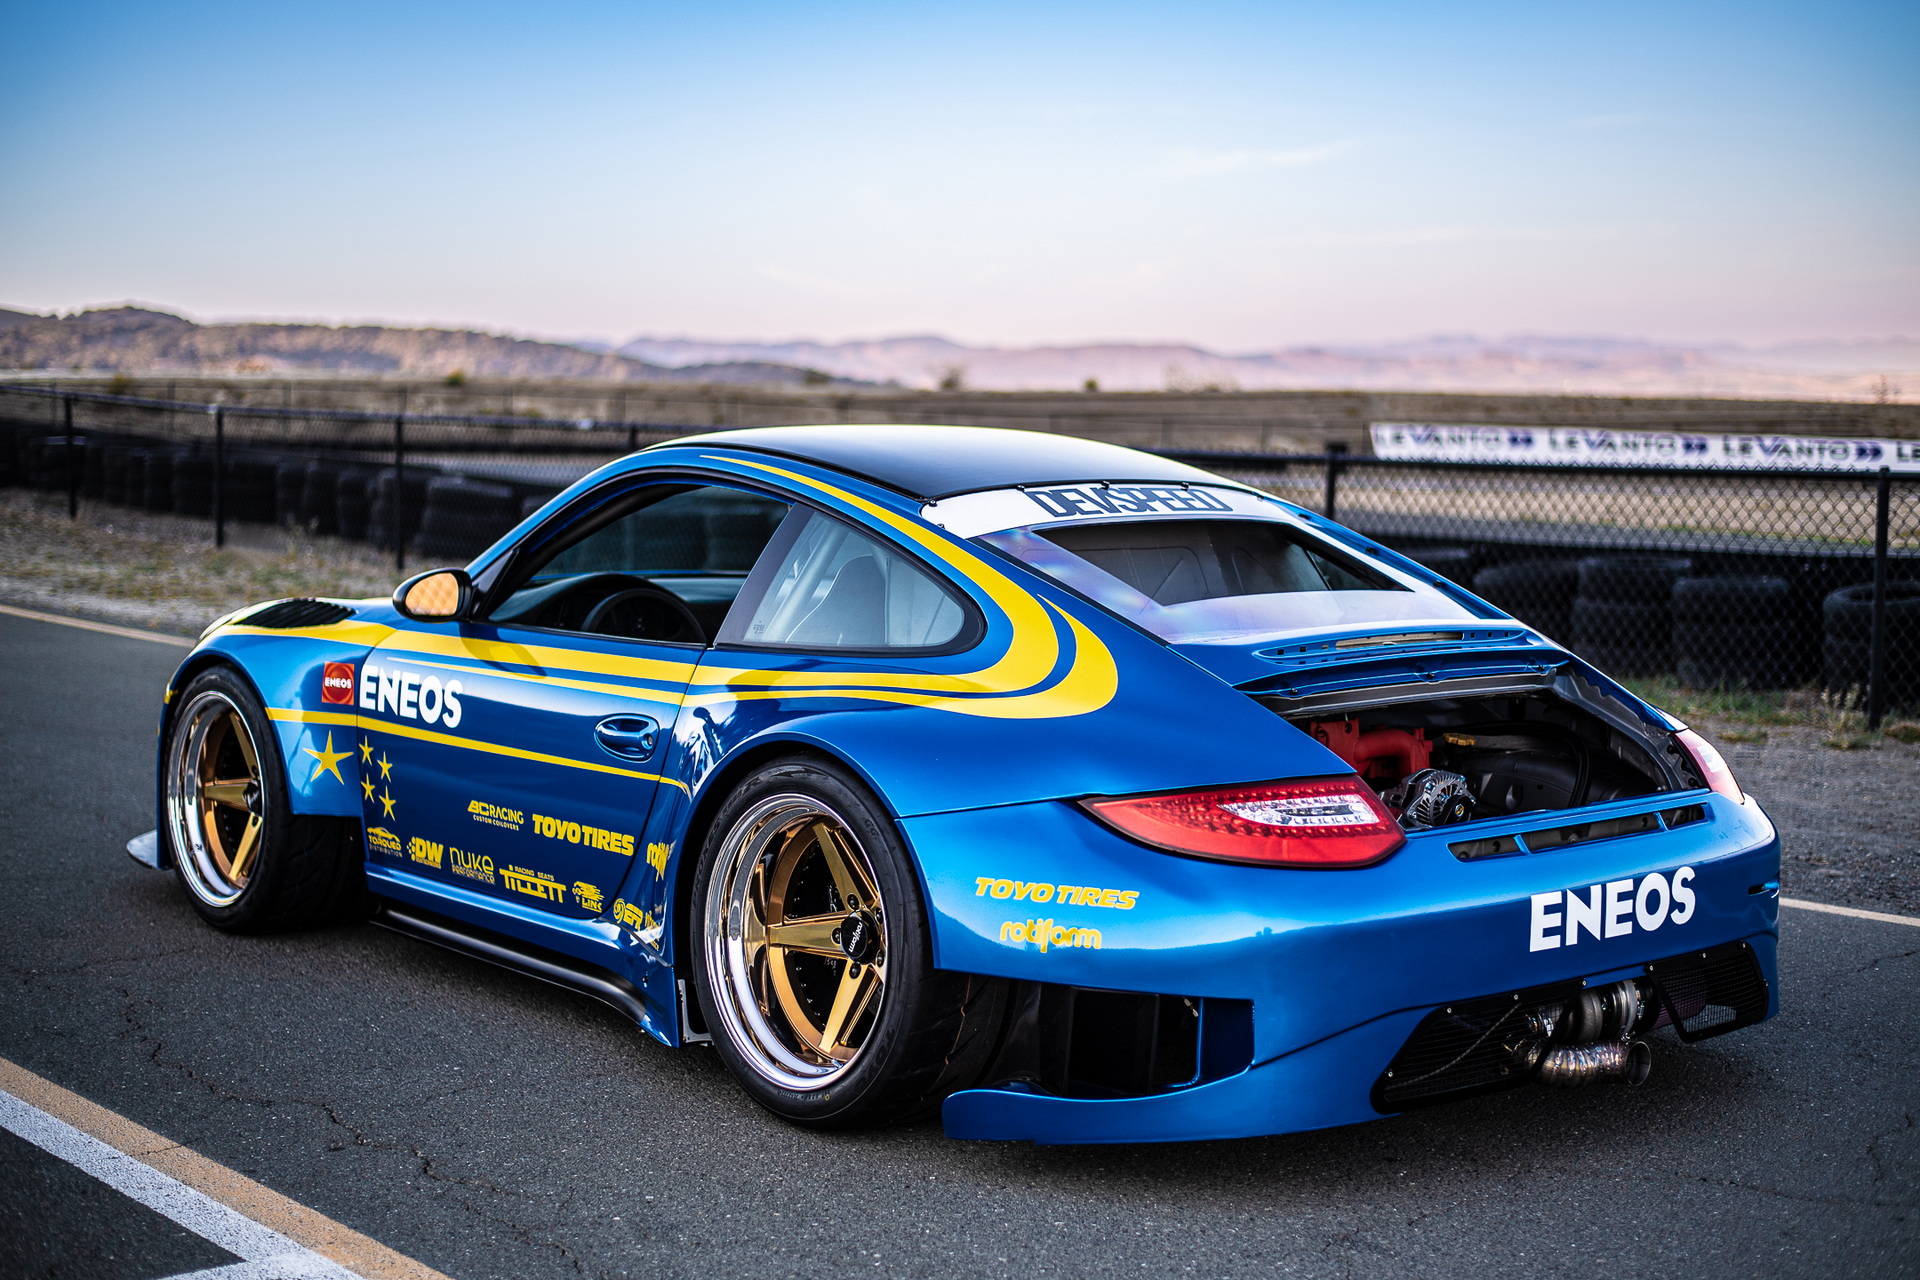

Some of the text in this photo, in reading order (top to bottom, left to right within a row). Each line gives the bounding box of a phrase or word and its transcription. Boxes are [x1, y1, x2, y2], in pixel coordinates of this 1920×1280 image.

[1722, 434, 1850, 462] LEVANTO
[1023, 487, 1234, 518] DEVSPEED
[324, 676, 353, 690] ENEOS
[359, 664, 464, 729] ENEOS
[415, 837, 444, 864] DW
[581, 825, 635, 857] TIRES
[975, 877, 1140, 910] TOYO TIRES
[1529, 866, 1697, 953] ENEOS
[1000, 918, 1102, 953] rotiform
